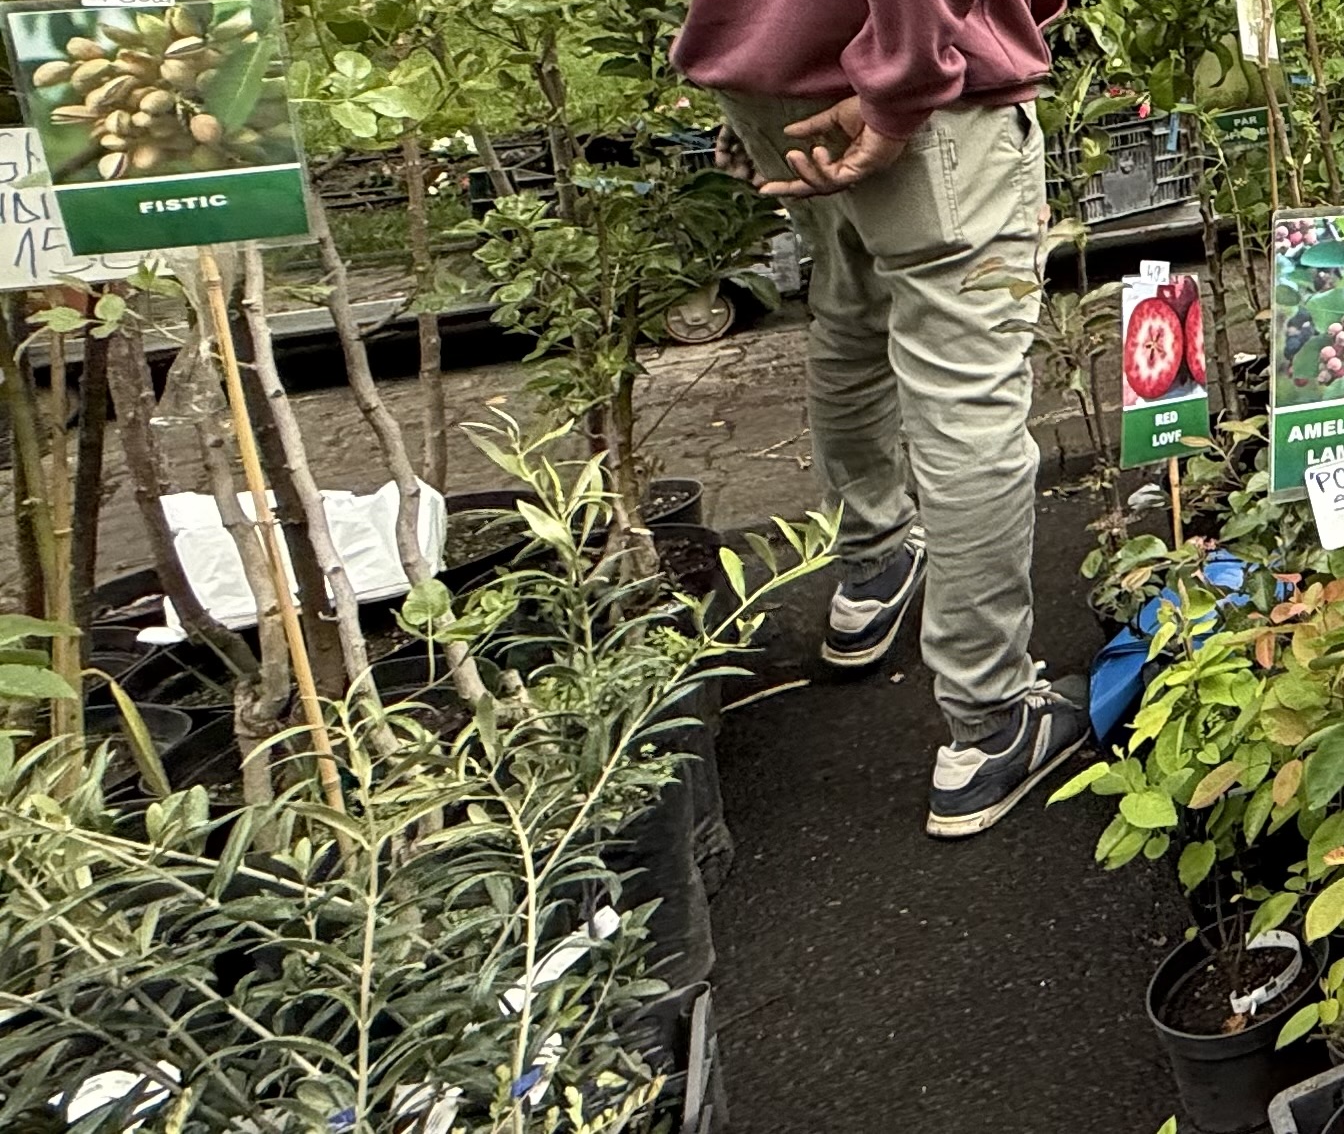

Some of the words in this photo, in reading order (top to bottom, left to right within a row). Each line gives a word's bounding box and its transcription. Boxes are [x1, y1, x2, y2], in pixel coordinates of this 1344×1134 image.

[1233, 115, 1258, 127] PAR
[138, 193, 229, 215] FISTIC
[1154, 410, 1179, 427] RED
